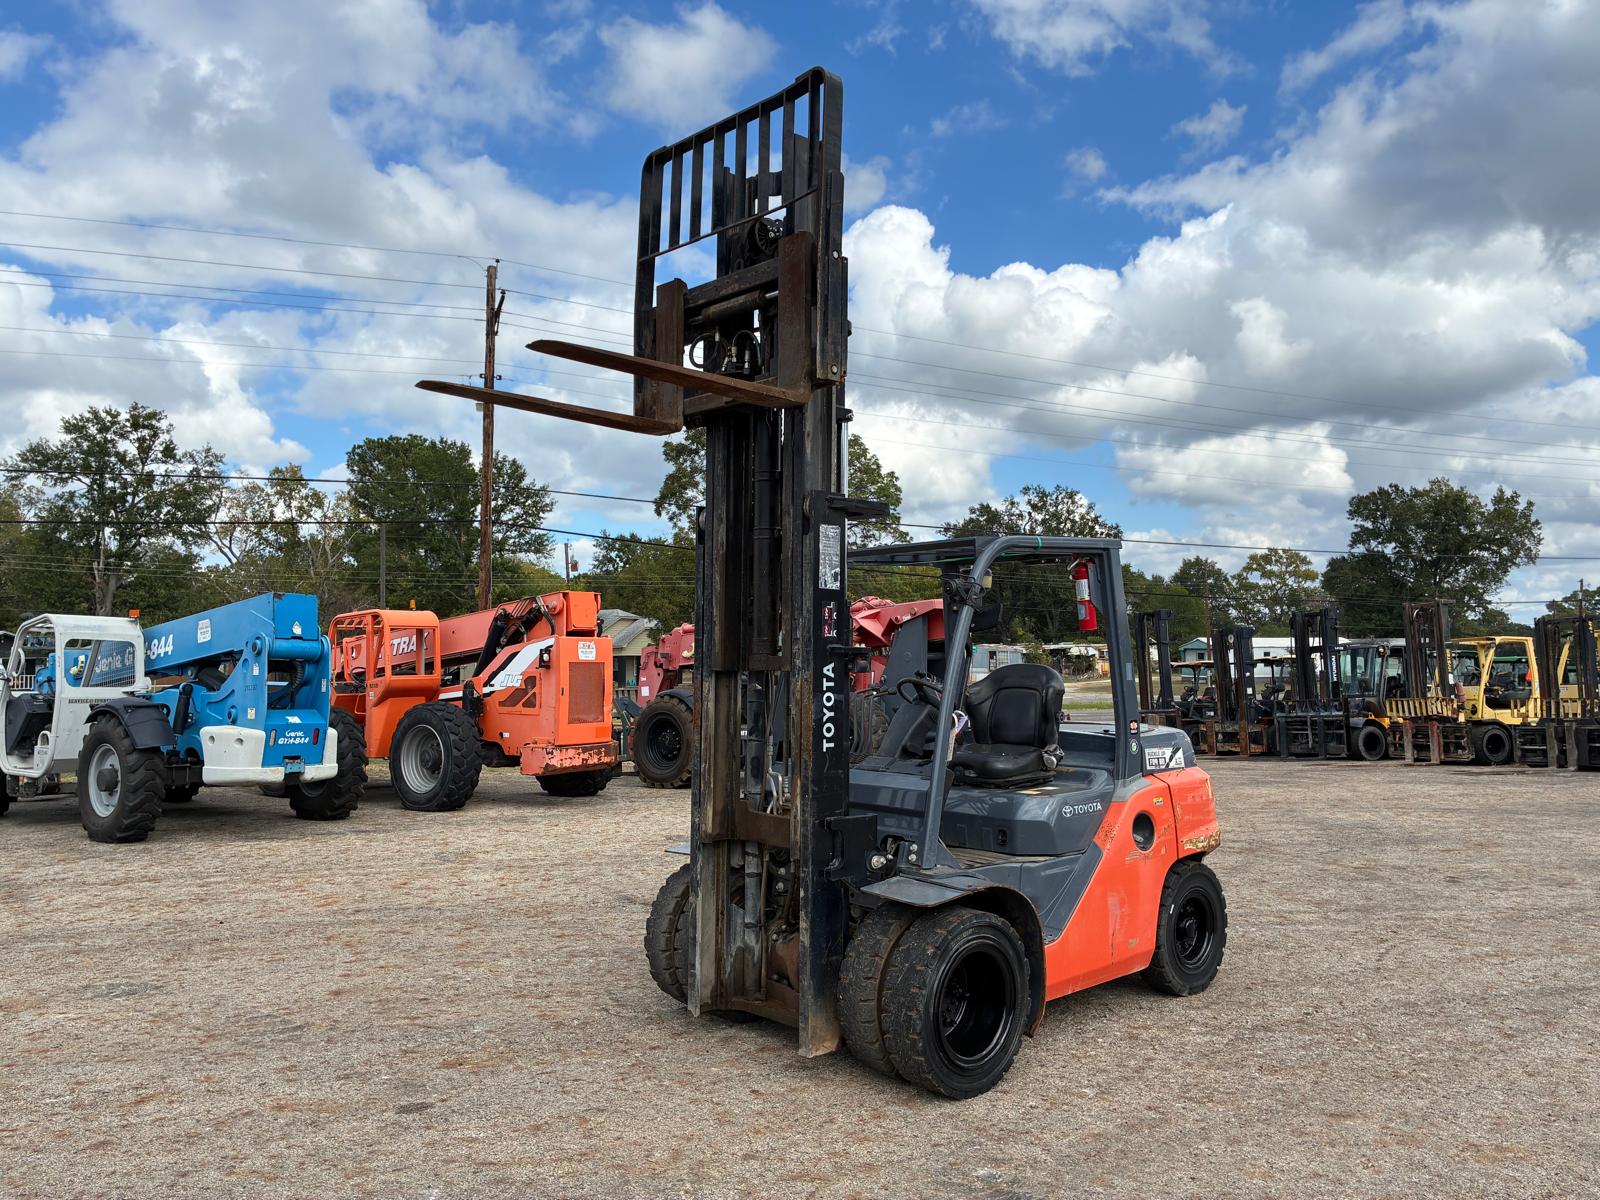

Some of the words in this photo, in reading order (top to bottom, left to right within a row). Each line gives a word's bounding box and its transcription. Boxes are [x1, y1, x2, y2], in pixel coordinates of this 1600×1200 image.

[500, 674, 523, 687] JLG
[822, 662, 835, 752] TOYOTA
[1073, 802, 1102, 815] TOYOTA
